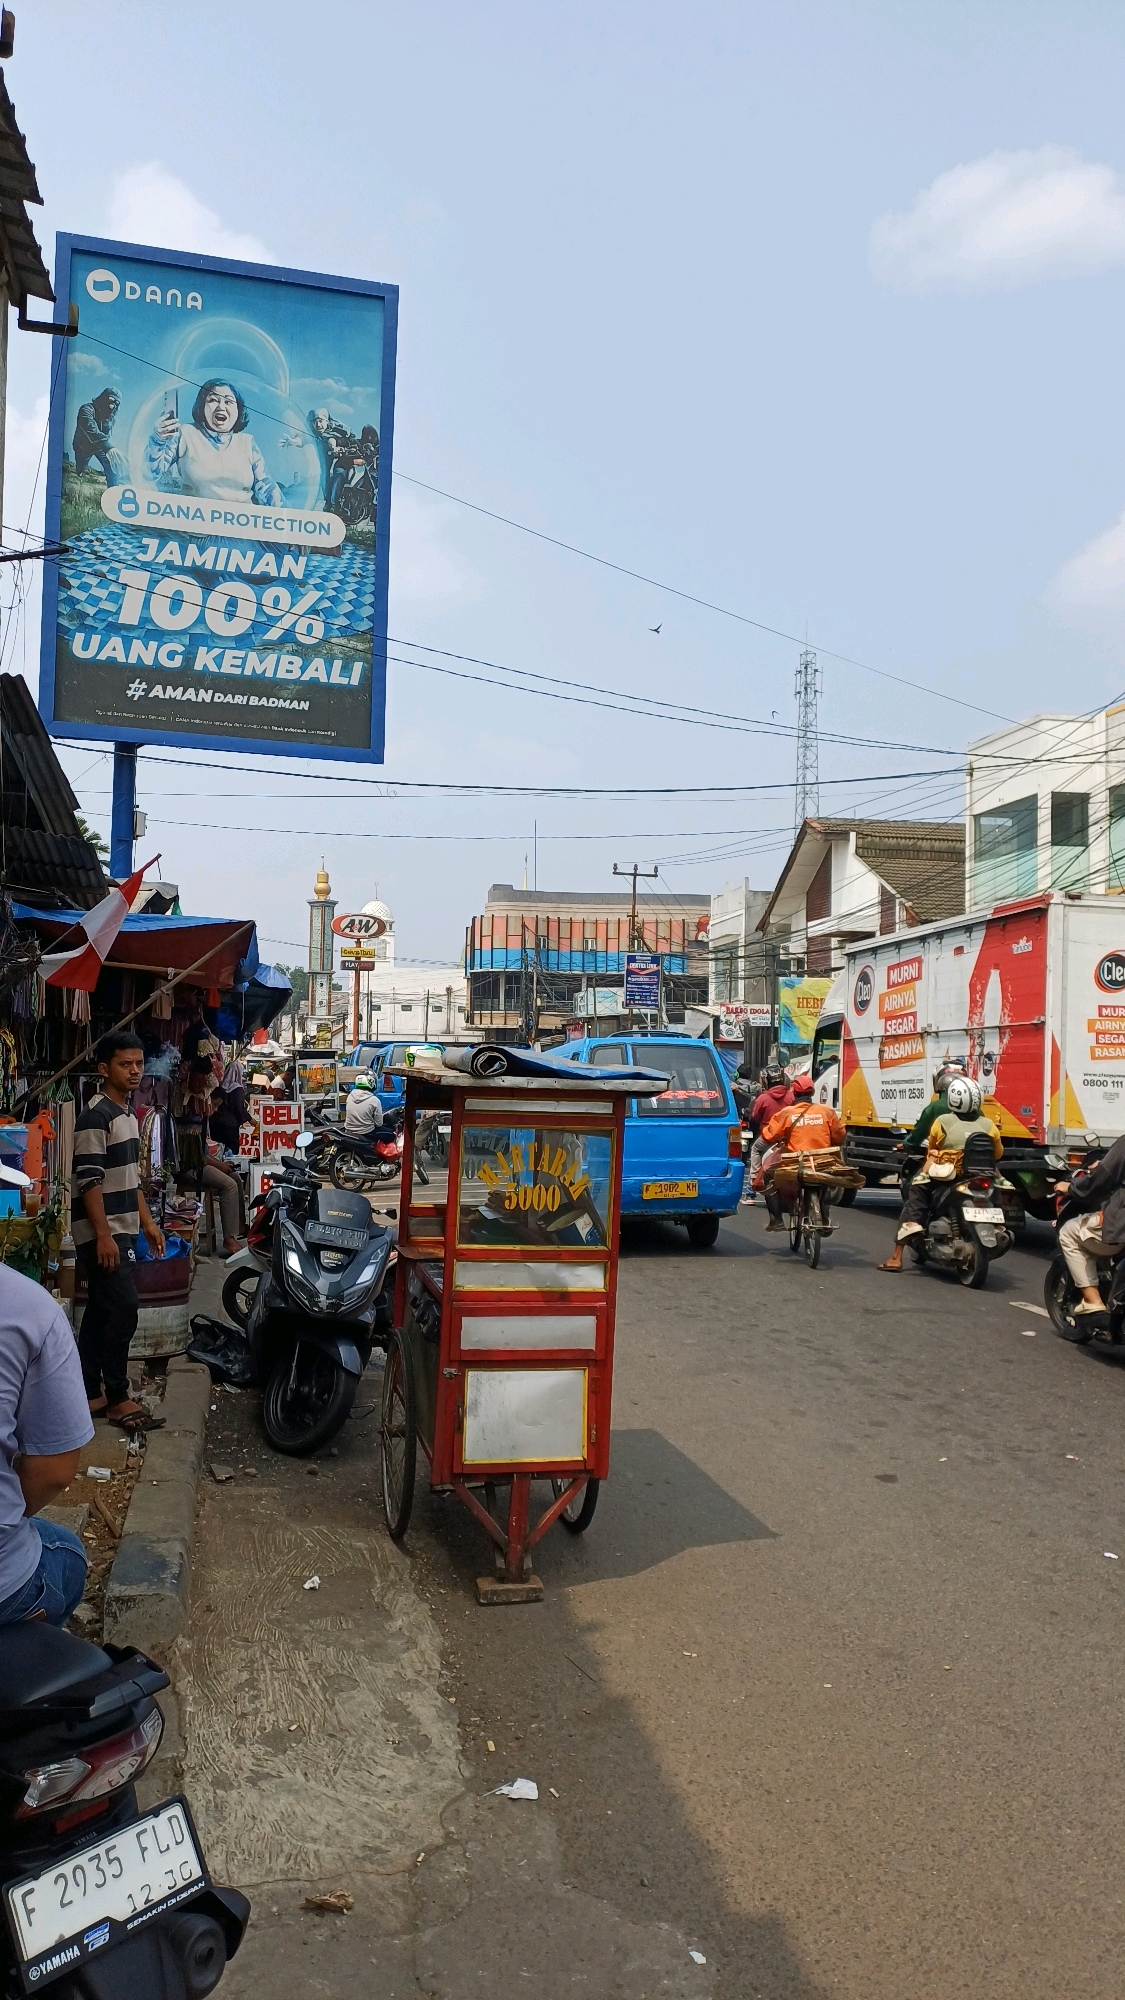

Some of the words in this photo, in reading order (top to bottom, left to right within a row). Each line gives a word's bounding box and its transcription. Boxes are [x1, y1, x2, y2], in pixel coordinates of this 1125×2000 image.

[125, 281, 202, 310] DANA
[146, 501, 206, 522] DANA
[210, 509, 331, 536] PROTECTION
[136, 538, 307, 579] JAMINAN
[118, 569, 325, 645] 100%
[72, 632, 186, 668] UANG
[193, 646, 364, 686] KEMBALI
[341, 919, 377, 933] A&W
[890, 962, 919, 985] MURNI
[858, 981, 871, 1003] Cleo
[884, 989, 916, 1012] AIRNYA
[886, 1015, 914, 1034] SEGAR
[884, 1038, 923, 1061] RASANYA
[881, 1089, 897, 1100] 0800
[899, 1089, 907, 1099] 111
[908, 1088, 925, 1099] 2538
[1083, 1079, 1108, 1087] 0800
[1111, 1080, 1123, 1088] 111
[262, 1105, 301, 1125] BELI
[476, 1142, 592, 1201] MARTABAK
[504, 1183, 561, 1212] 5000
[21, 1887, 35, 1927] F
[54, 1845, 123, 1908] 2935
[136, 1815, 185, 1863] FLD
[126, 1903, 167, 1931] SEMAKIN
[167, 1899, 176, 1907] DI
[177, 1881, 206, 1901] DEPAN
[39, 1945, 81, 1975] YAMAHA
